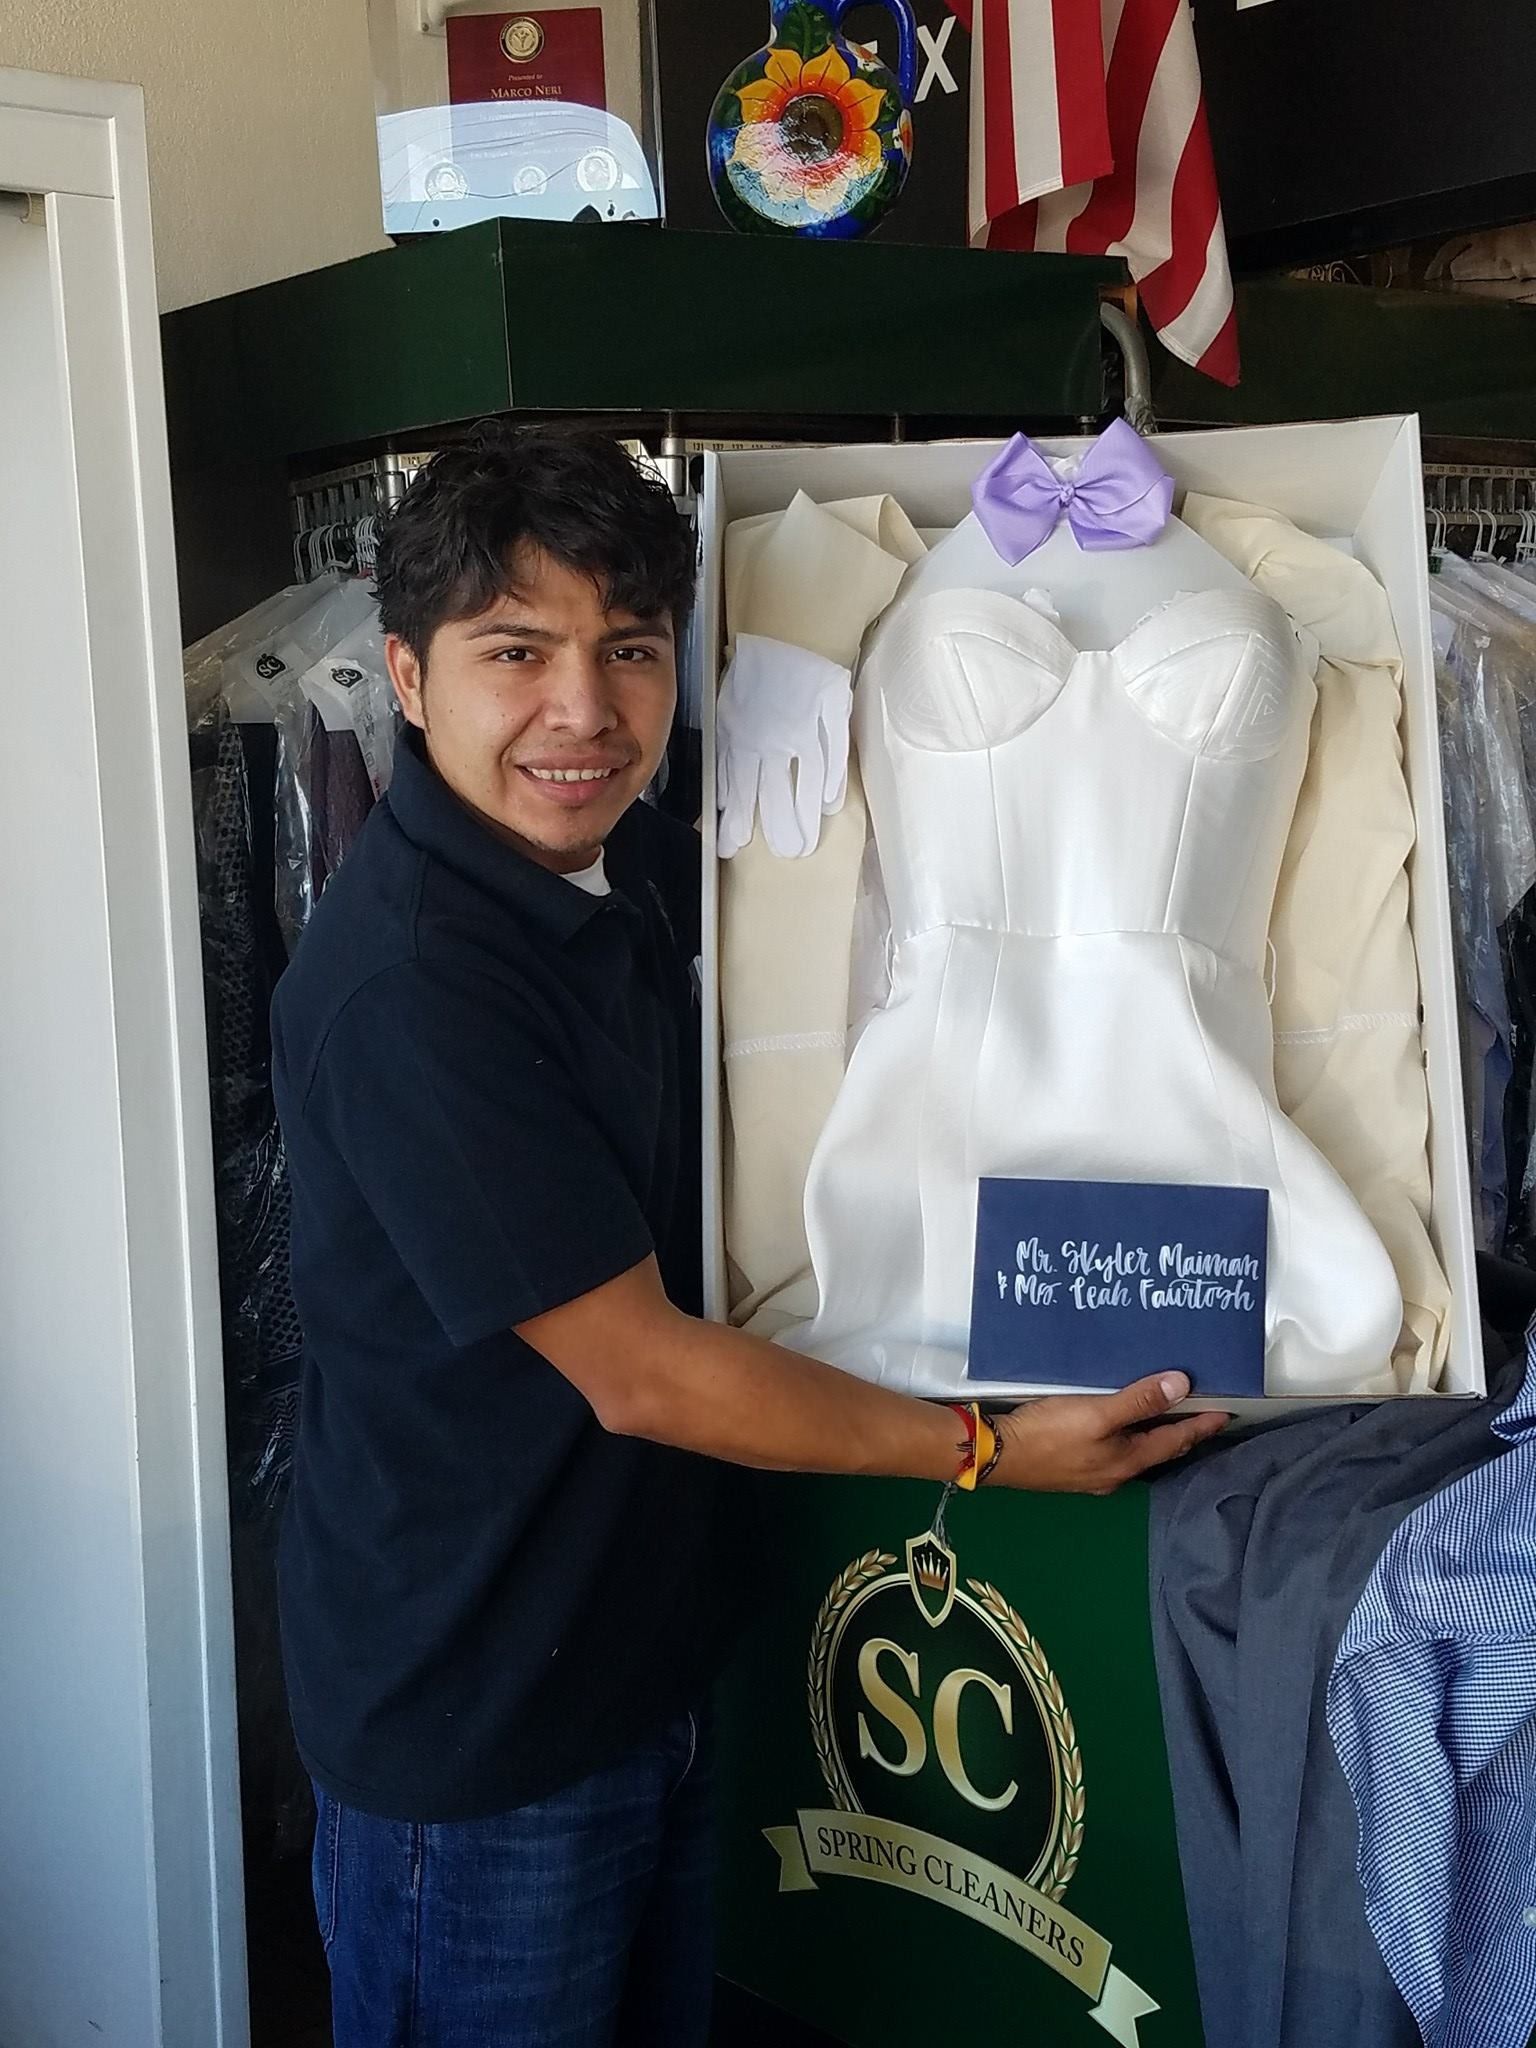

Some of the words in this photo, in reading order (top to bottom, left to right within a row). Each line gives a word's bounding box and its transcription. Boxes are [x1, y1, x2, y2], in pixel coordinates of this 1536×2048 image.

[535, 85, 562, 96] NERI
[258, 659, 281, 677] SC
[336, 669, 358, 684] SC
[1016, 1237, 1058, 1274] Mr.
[1069, 1276, 1132, 1310] Leah
[858, 1637, 1019, 1812] SC
[817, 1826, 917, 1876] SPRING
[924, 1854, 1085, 1968] CLEANERS
